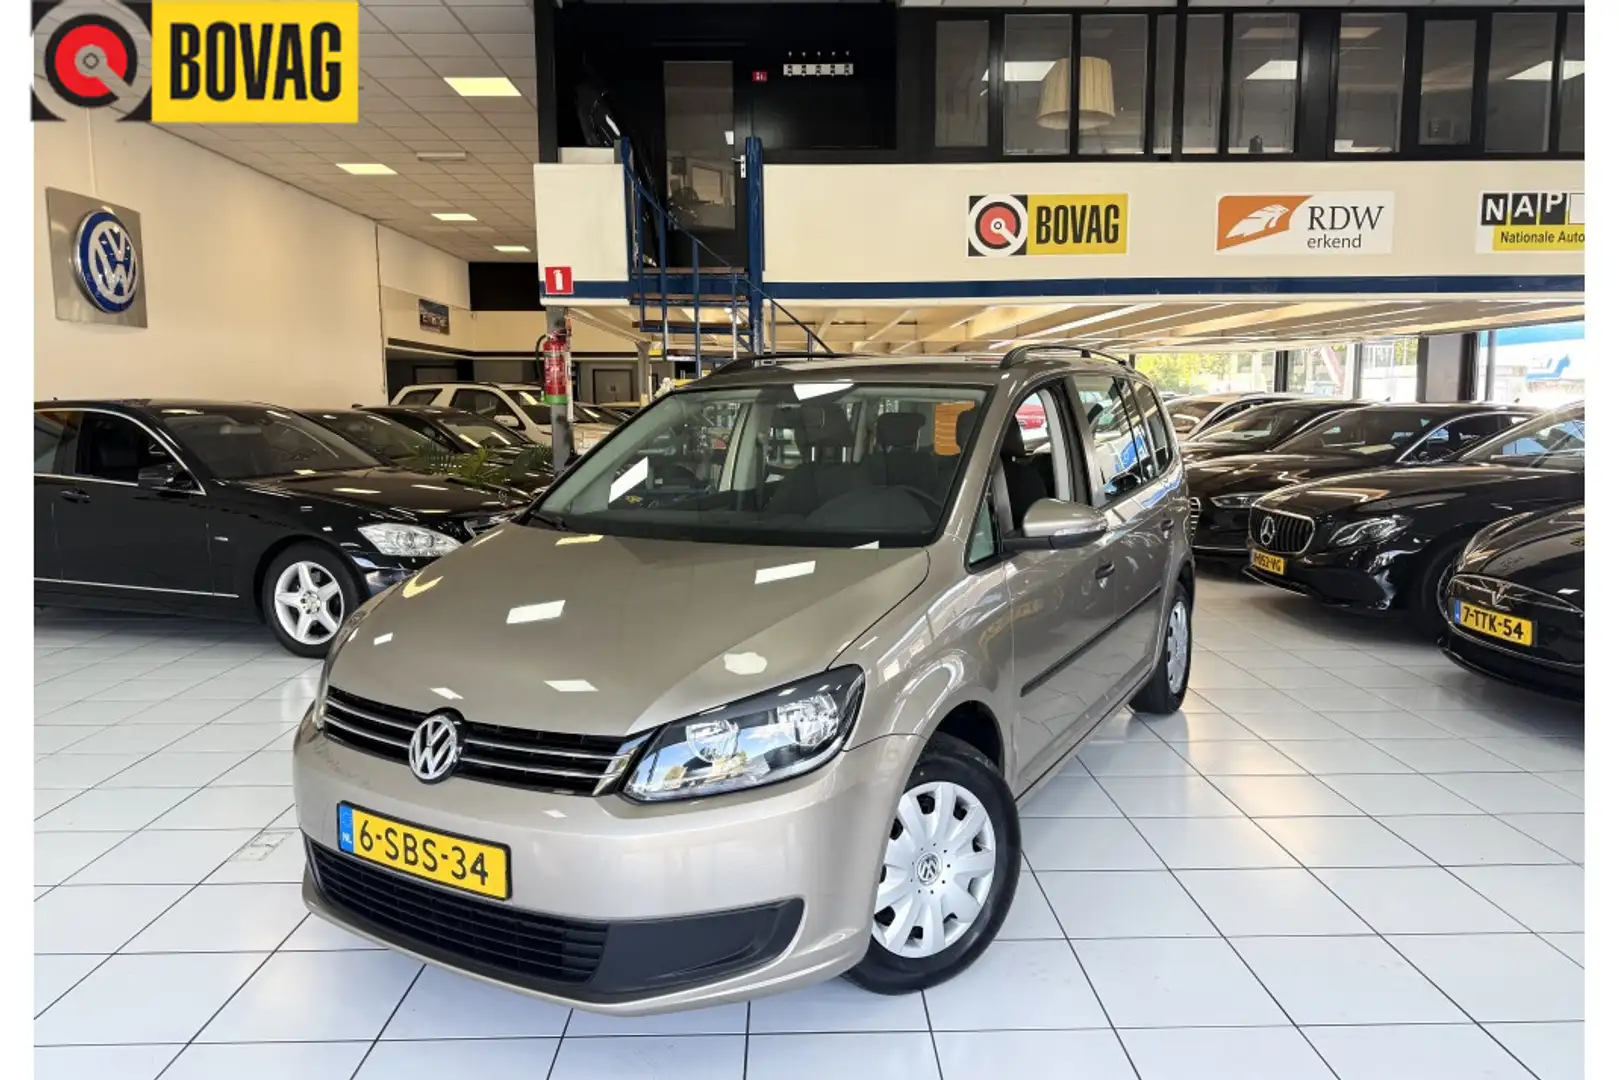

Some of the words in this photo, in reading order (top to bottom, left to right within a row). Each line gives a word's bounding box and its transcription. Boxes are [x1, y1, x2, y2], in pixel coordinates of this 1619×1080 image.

[1307, 205, 1385, 231] RDW
[1485, 193, 1564, 221] NAP
[1036, 204, 1120, 244] BOVAG
[1500, 230, 1556, 244] Nationale
[1557, 230, 1585, 244] Auto
[1306, 233, 1363, 249] erkend
[1463, 605, 1524, 640] 7-TTK-54
[360, 819, 489, 886] 6-SBS-34
